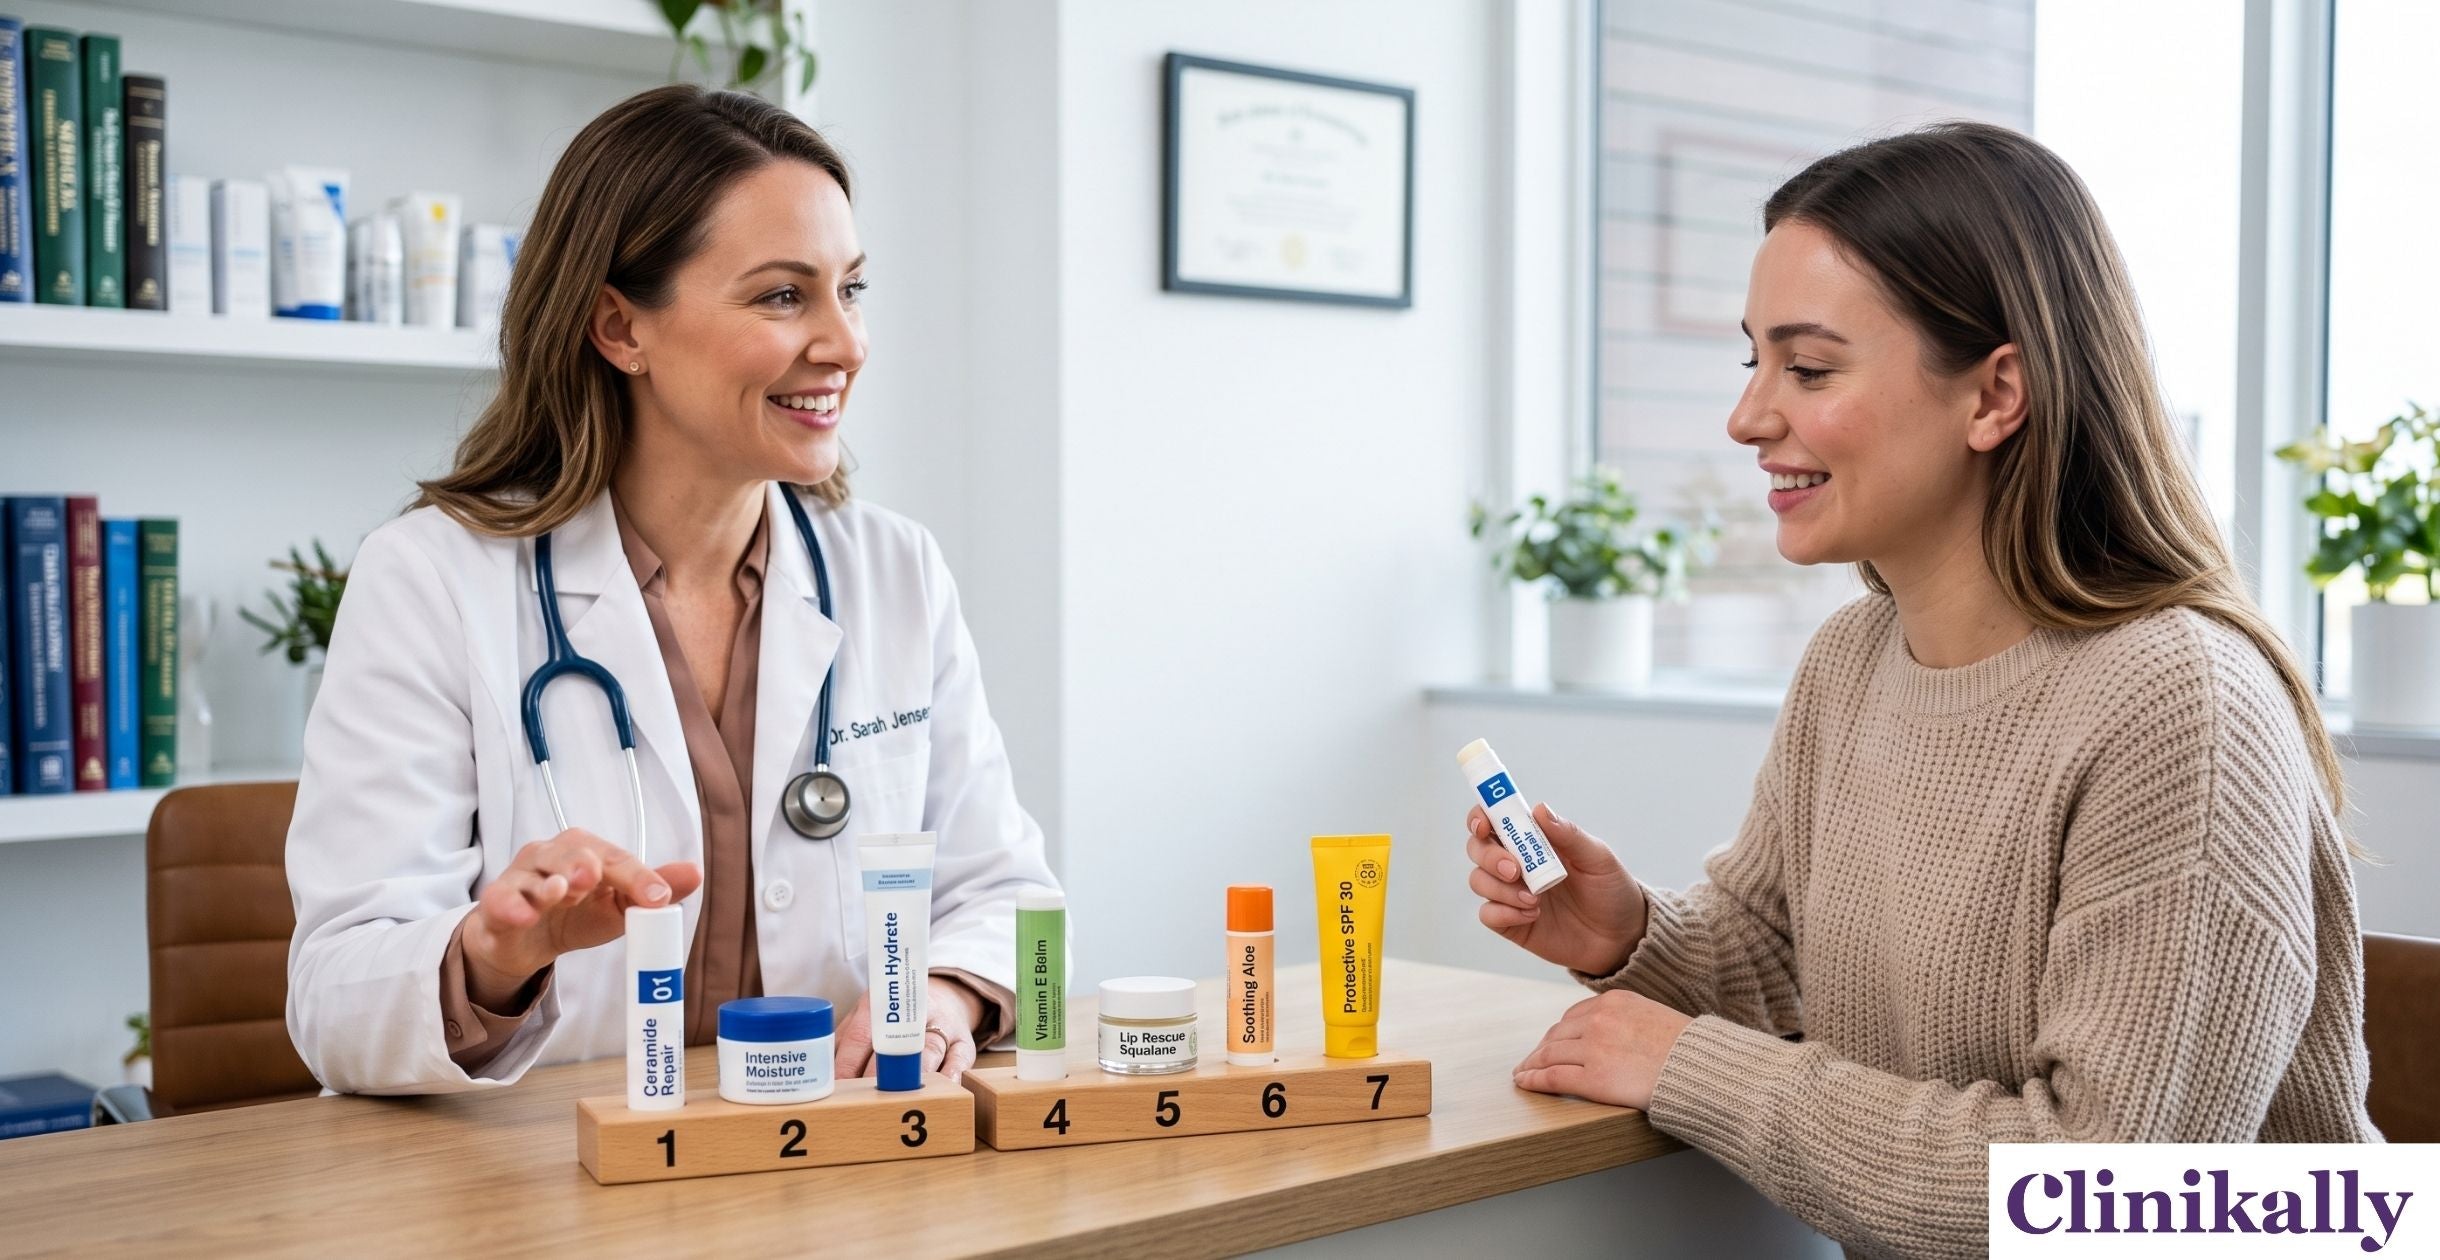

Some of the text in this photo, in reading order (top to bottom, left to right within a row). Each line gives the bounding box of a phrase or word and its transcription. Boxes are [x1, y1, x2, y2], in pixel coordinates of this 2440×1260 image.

[831, 707, 931, 746] Dr. Sarah Jense
[1488, 779, 1506, 799] 01
[1340, 881, 1357, 1013] Protective SPF 30
[652, 976, 673, 1001] 01
[1035, 978, 1047, 986] E
[1242, 945, 1258, 1043] Soothing Aloe
[886, 981, 900, 1023] Derm
[643, 1018, 658, 1097] Ceramide
[745, 1051, 807, 1064] Intensive
[1120, 1031, 1186, 1045] Lip Rescue
[1120, 1044, 1177, 1058] Squalane
[661, 1045, 677, 1096] Repair
[746, 1065, 805, 1077] Moisture
[1043, 1074, 1390, 1135] 4 5 6 7
[656, 1109, 928, 1167] 1 2 3
